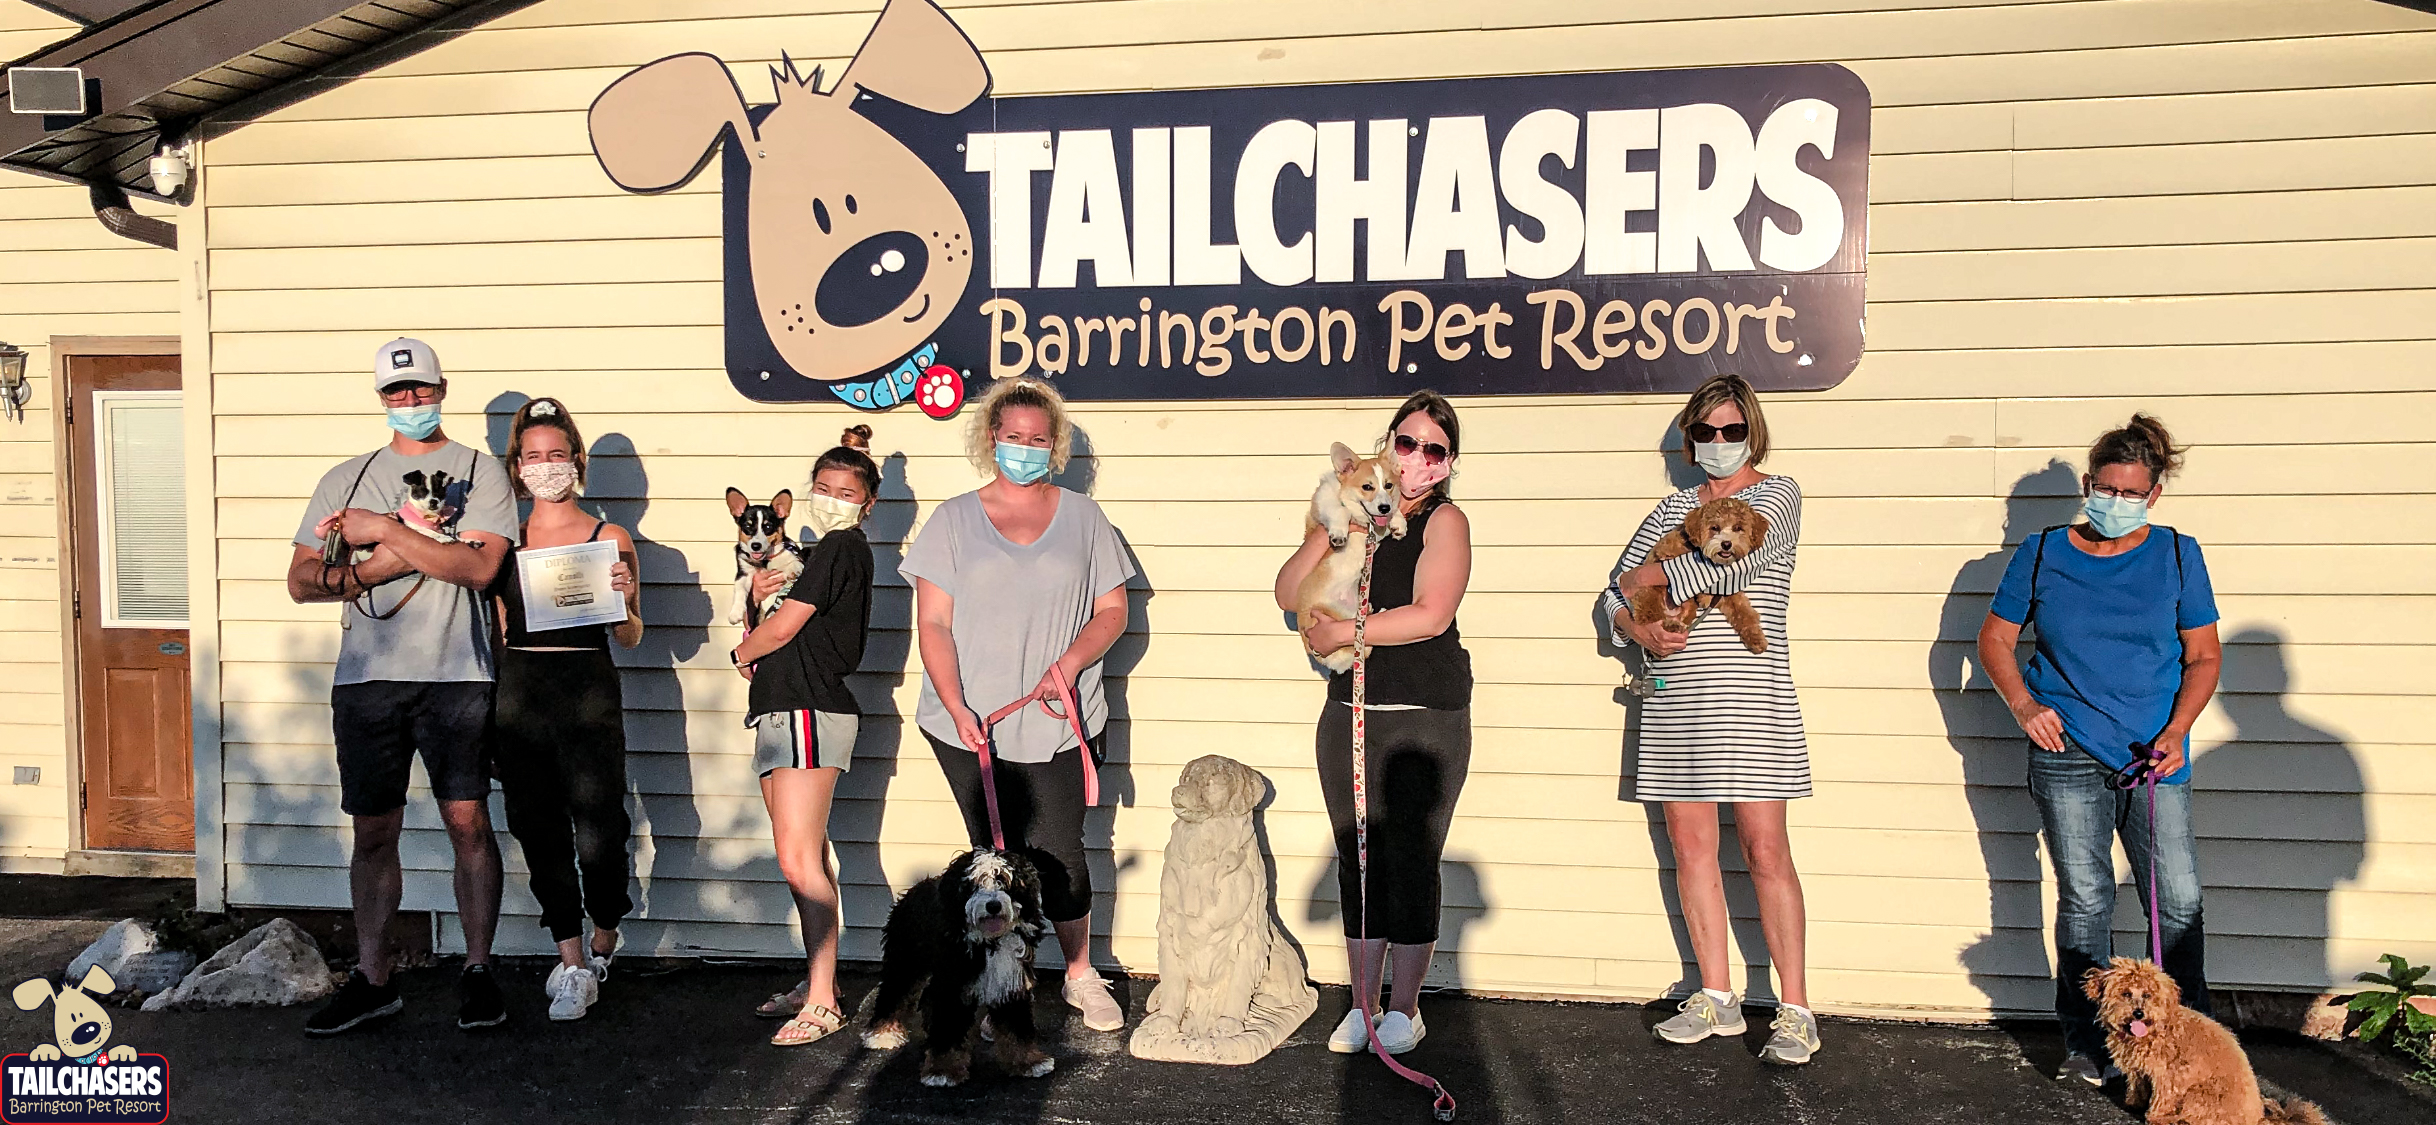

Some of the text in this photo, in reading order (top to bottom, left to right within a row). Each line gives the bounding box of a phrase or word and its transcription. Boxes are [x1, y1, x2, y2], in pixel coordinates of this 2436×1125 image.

[966, 98, 1845, 288] TAILCHASERS
[979, 289, 1796, 379] Barrington Pet Resort
[544, 554, 591, 568] DIPLOMA
